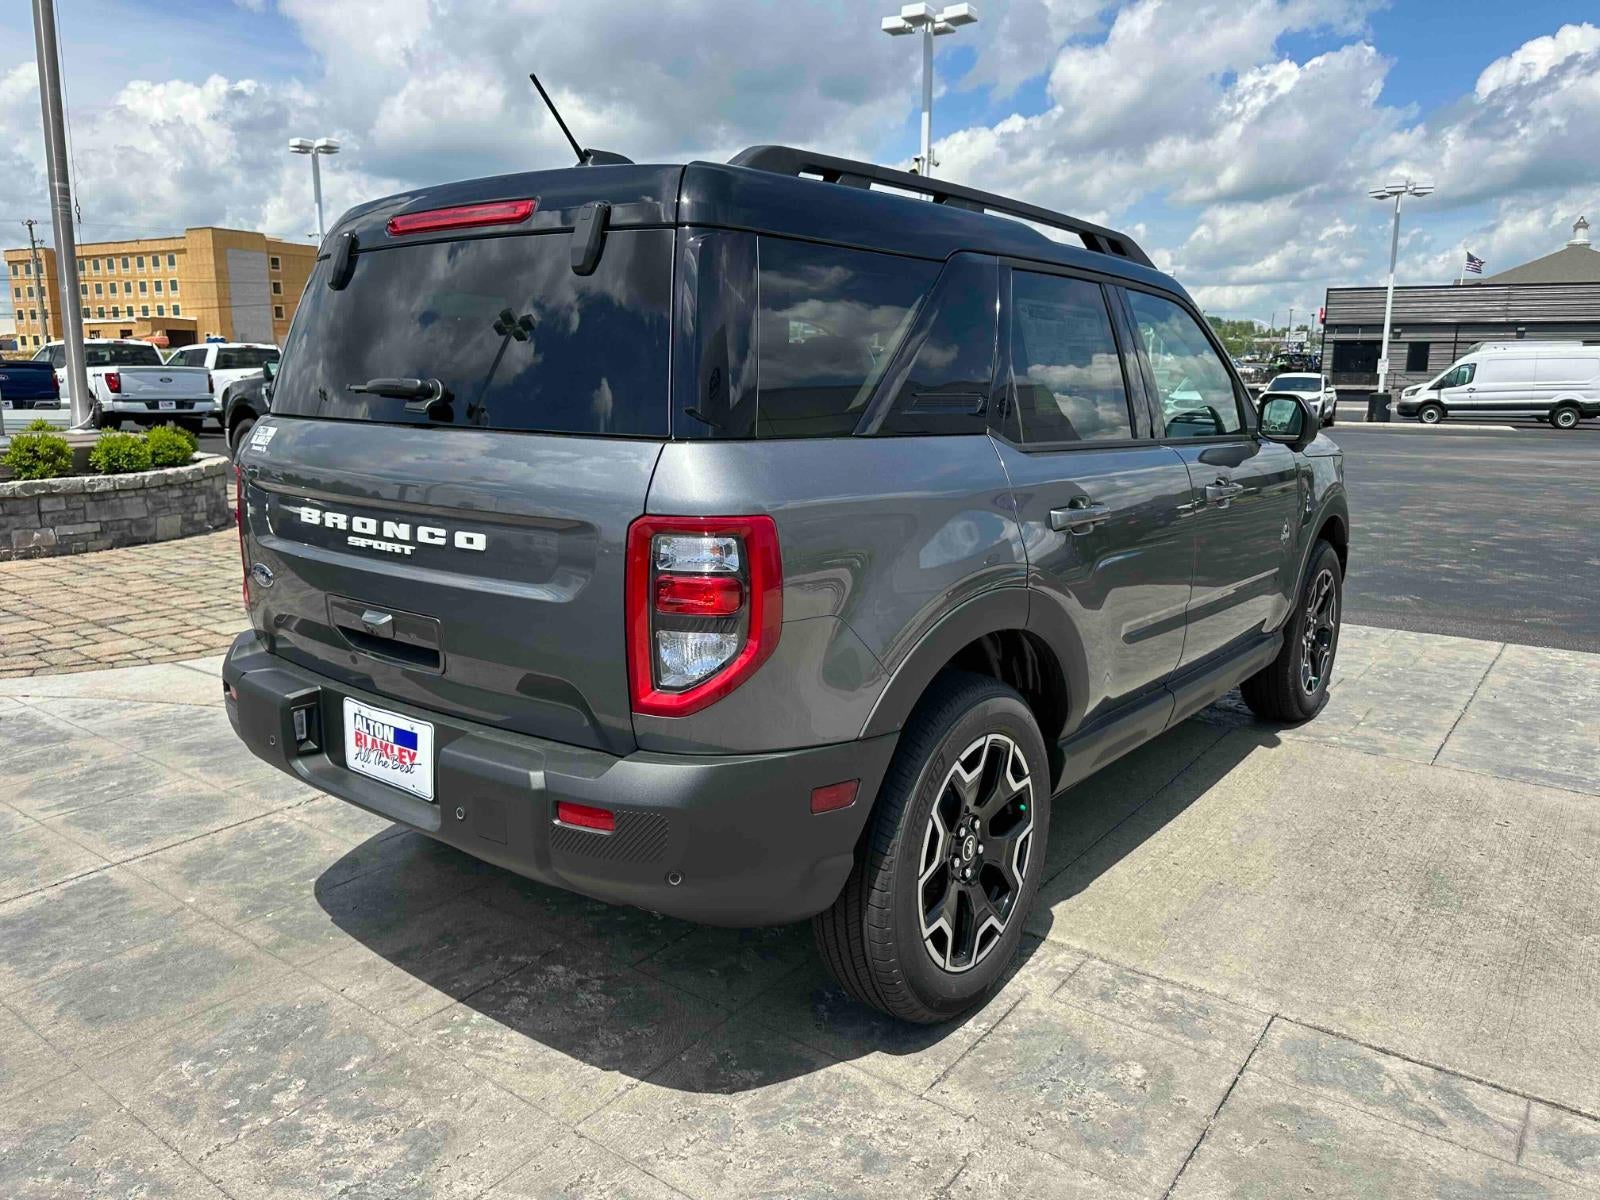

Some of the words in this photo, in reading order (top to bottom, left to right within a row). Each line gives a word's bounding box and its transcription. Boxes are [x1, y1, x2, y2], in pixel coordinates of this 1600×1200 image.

[301, 506, 487, 551] BRONCO
[347, 536, 416, 555] SPORT
[354, 713, 395, 744] ALTON
[371, 748, 390, 769] The
[391, 753, 422, 775] Best
